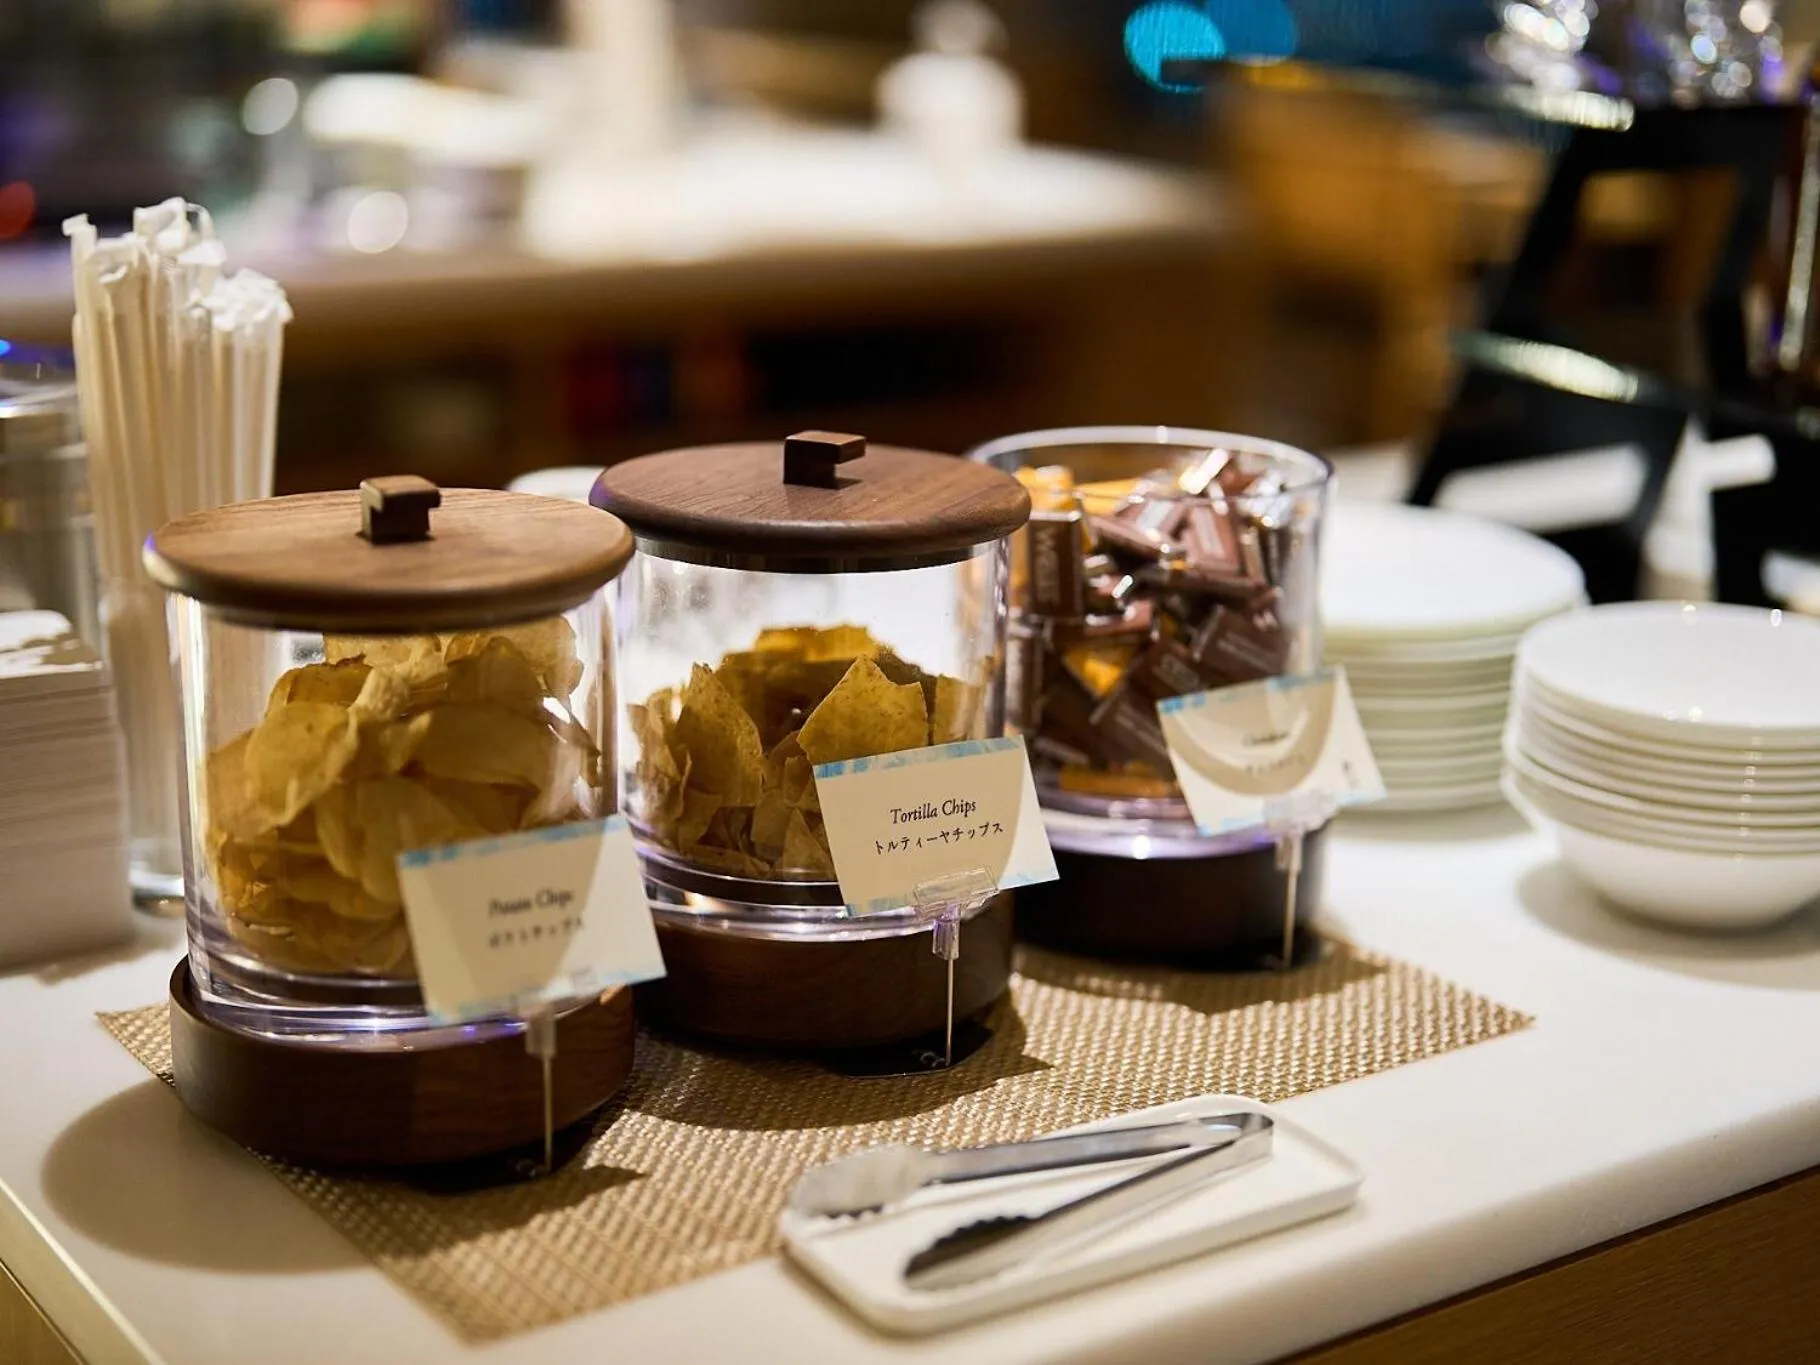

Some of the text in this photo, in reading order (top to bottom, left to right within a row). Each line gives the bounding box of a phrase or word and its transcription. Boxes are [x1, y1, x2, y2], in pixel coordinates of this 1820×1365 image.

[890, 798, 977, 824] Tortilla Chips
[875, 821, 1004, 855] トルティーヤチップス
